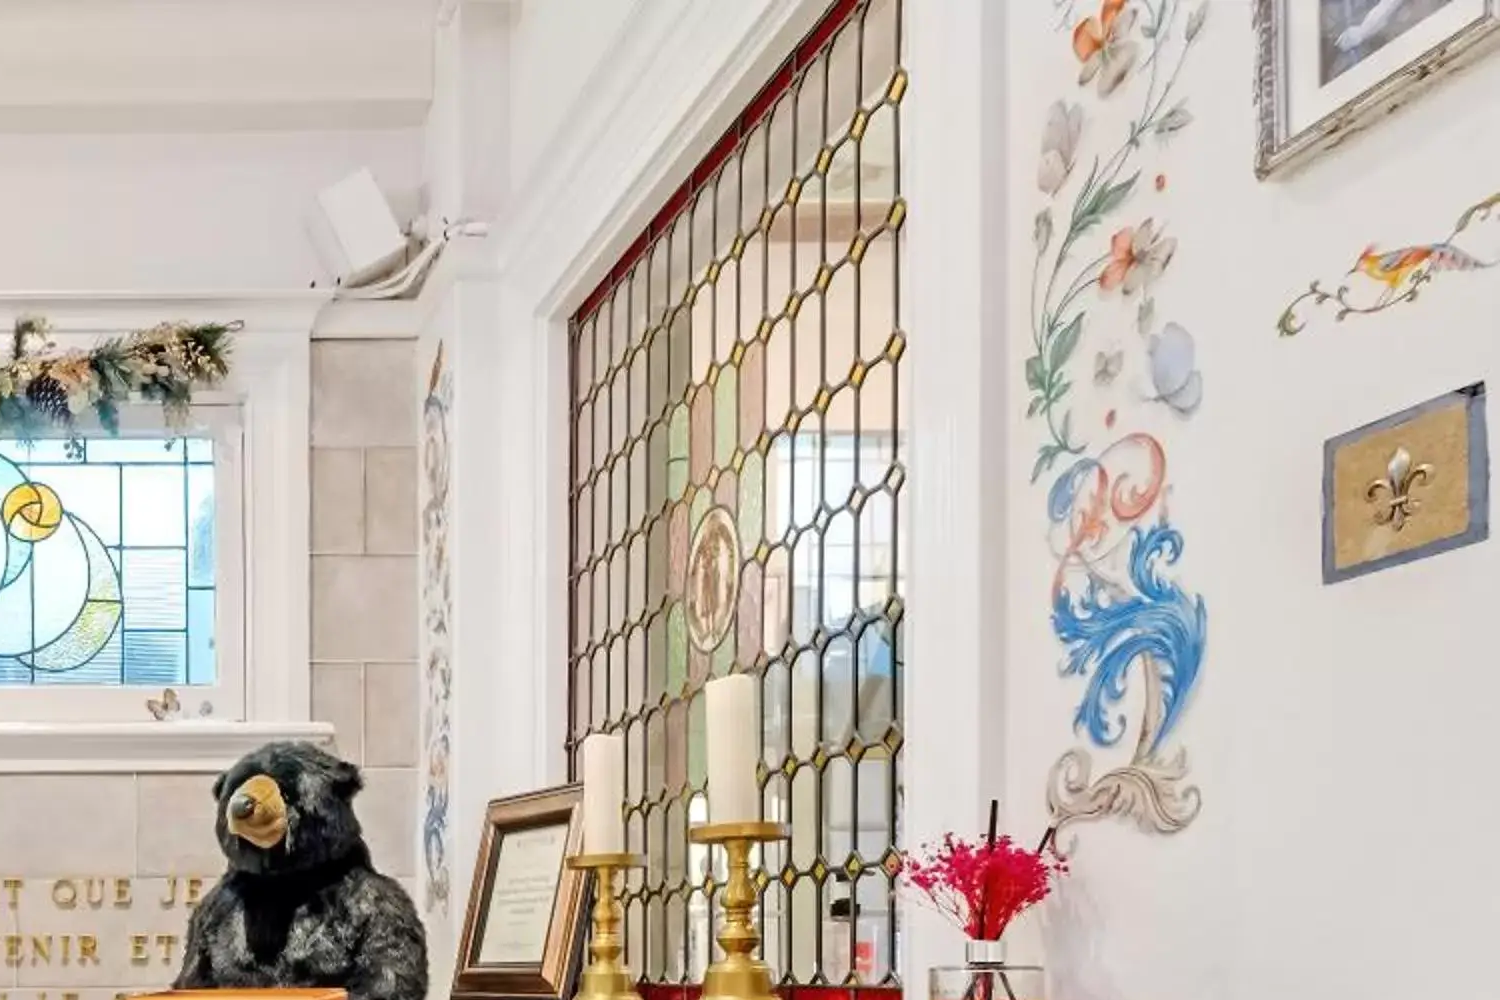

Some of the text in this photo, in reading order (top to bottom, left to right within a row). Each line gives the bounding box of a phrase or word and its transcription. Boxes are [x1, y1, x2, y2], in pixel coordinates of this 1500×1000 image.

[52, 878, 133, 908] QUE
[160, 876, 203, 907] JE
[130, 934, 179, 964] ET
